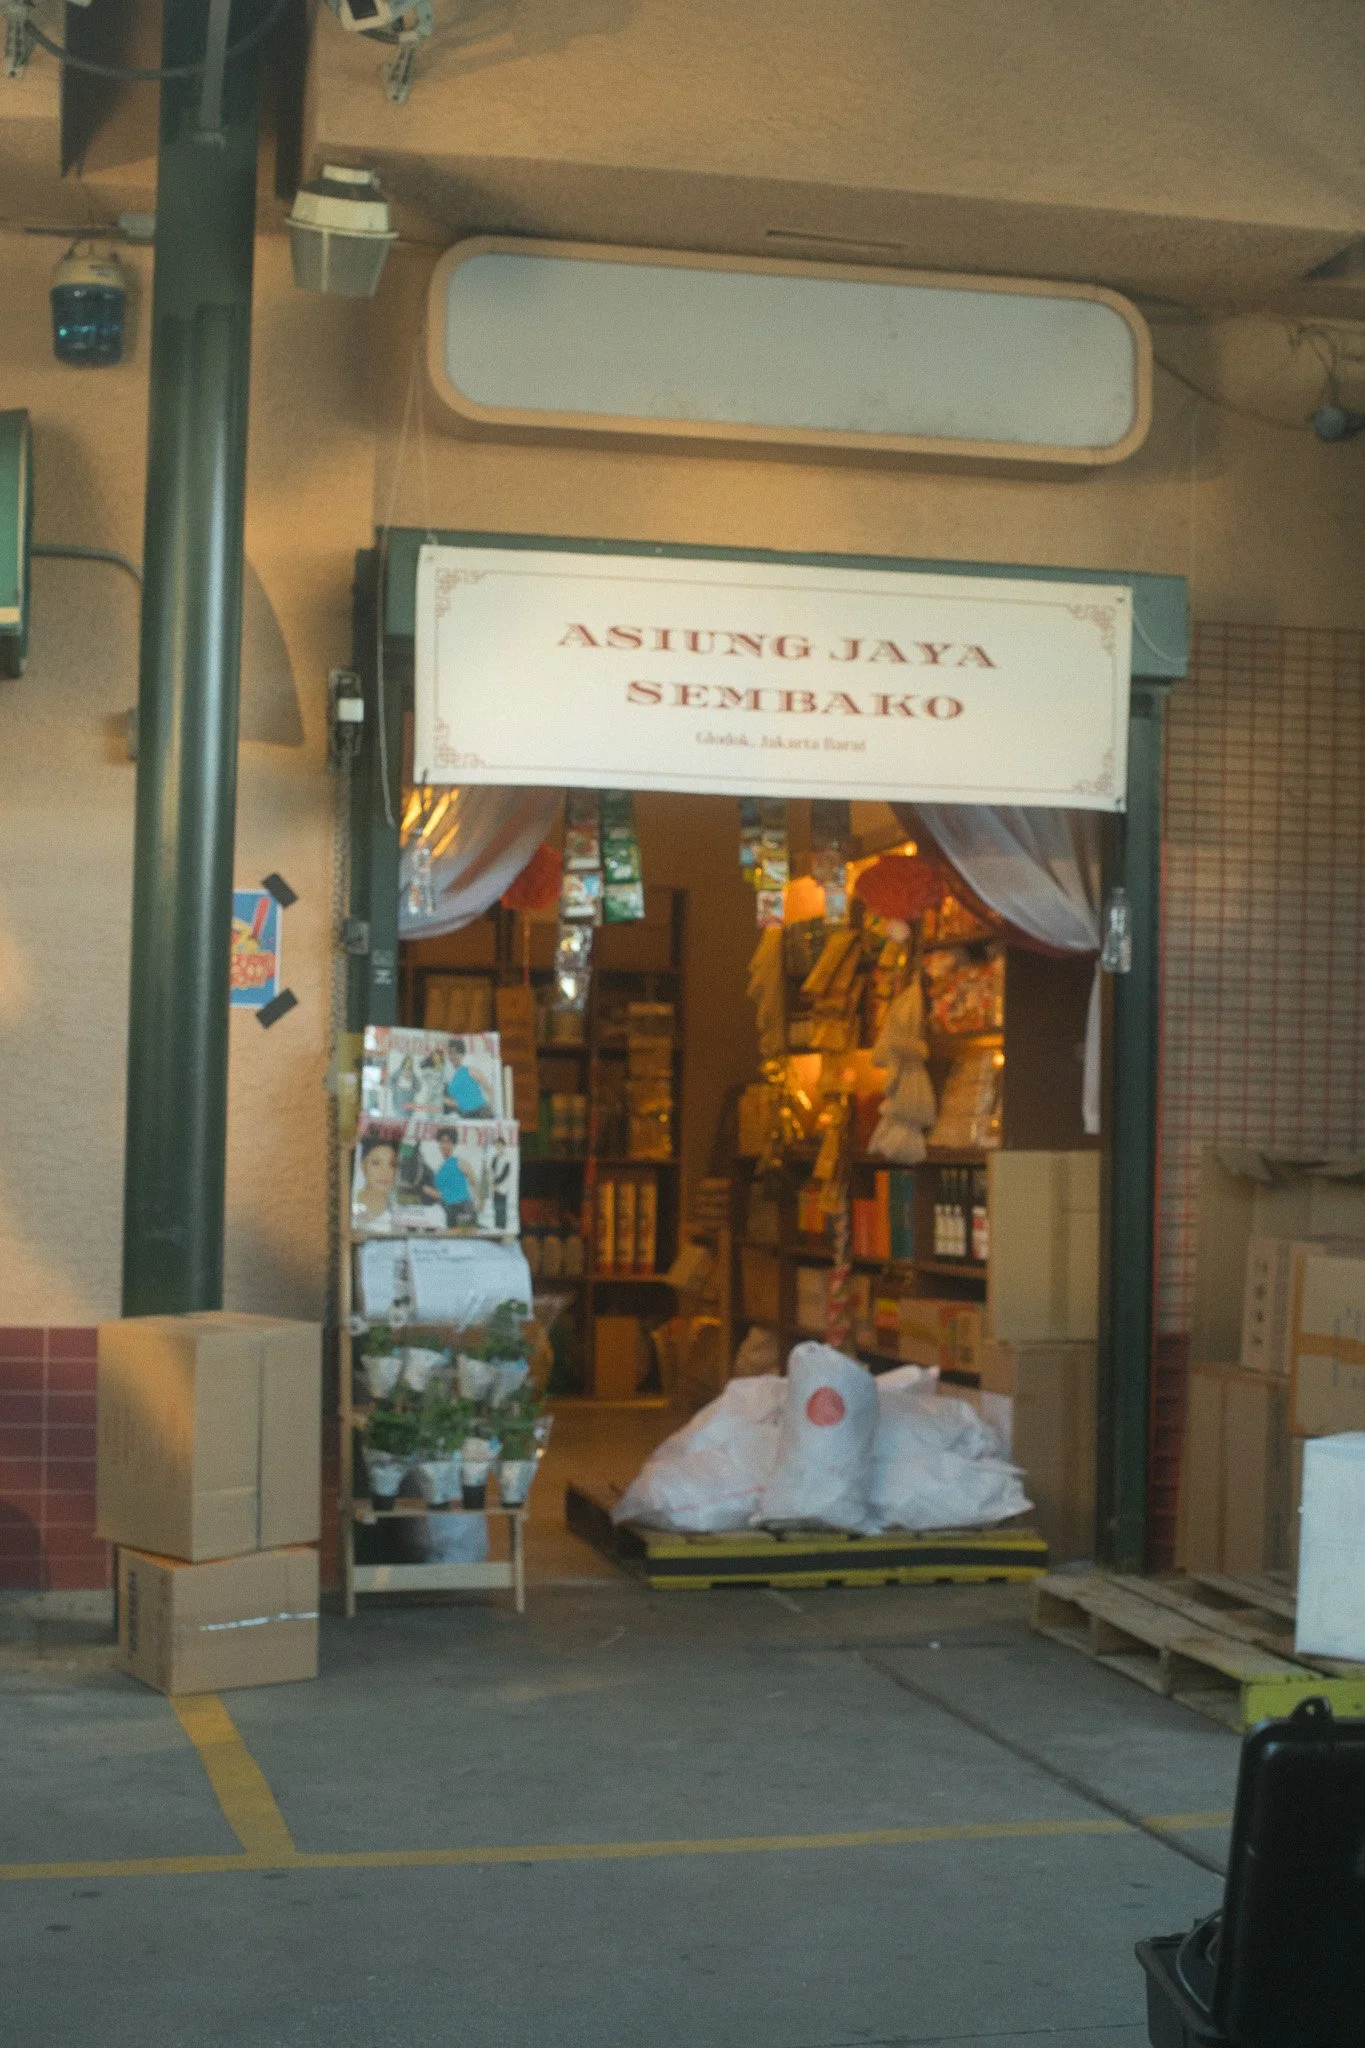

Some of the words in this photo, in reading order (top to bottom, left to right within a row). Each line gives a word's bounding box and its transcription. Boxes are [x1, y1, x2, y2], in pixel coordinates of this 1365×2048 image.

[557, 622, 815, 662] ASIUNG
[828, 637, 999, 669] JAYA
[626, 679, 965, 721] SEMBAKO
[760, 734, 820, 750] Jakarta
[823, 737, 867, 752] Barat
